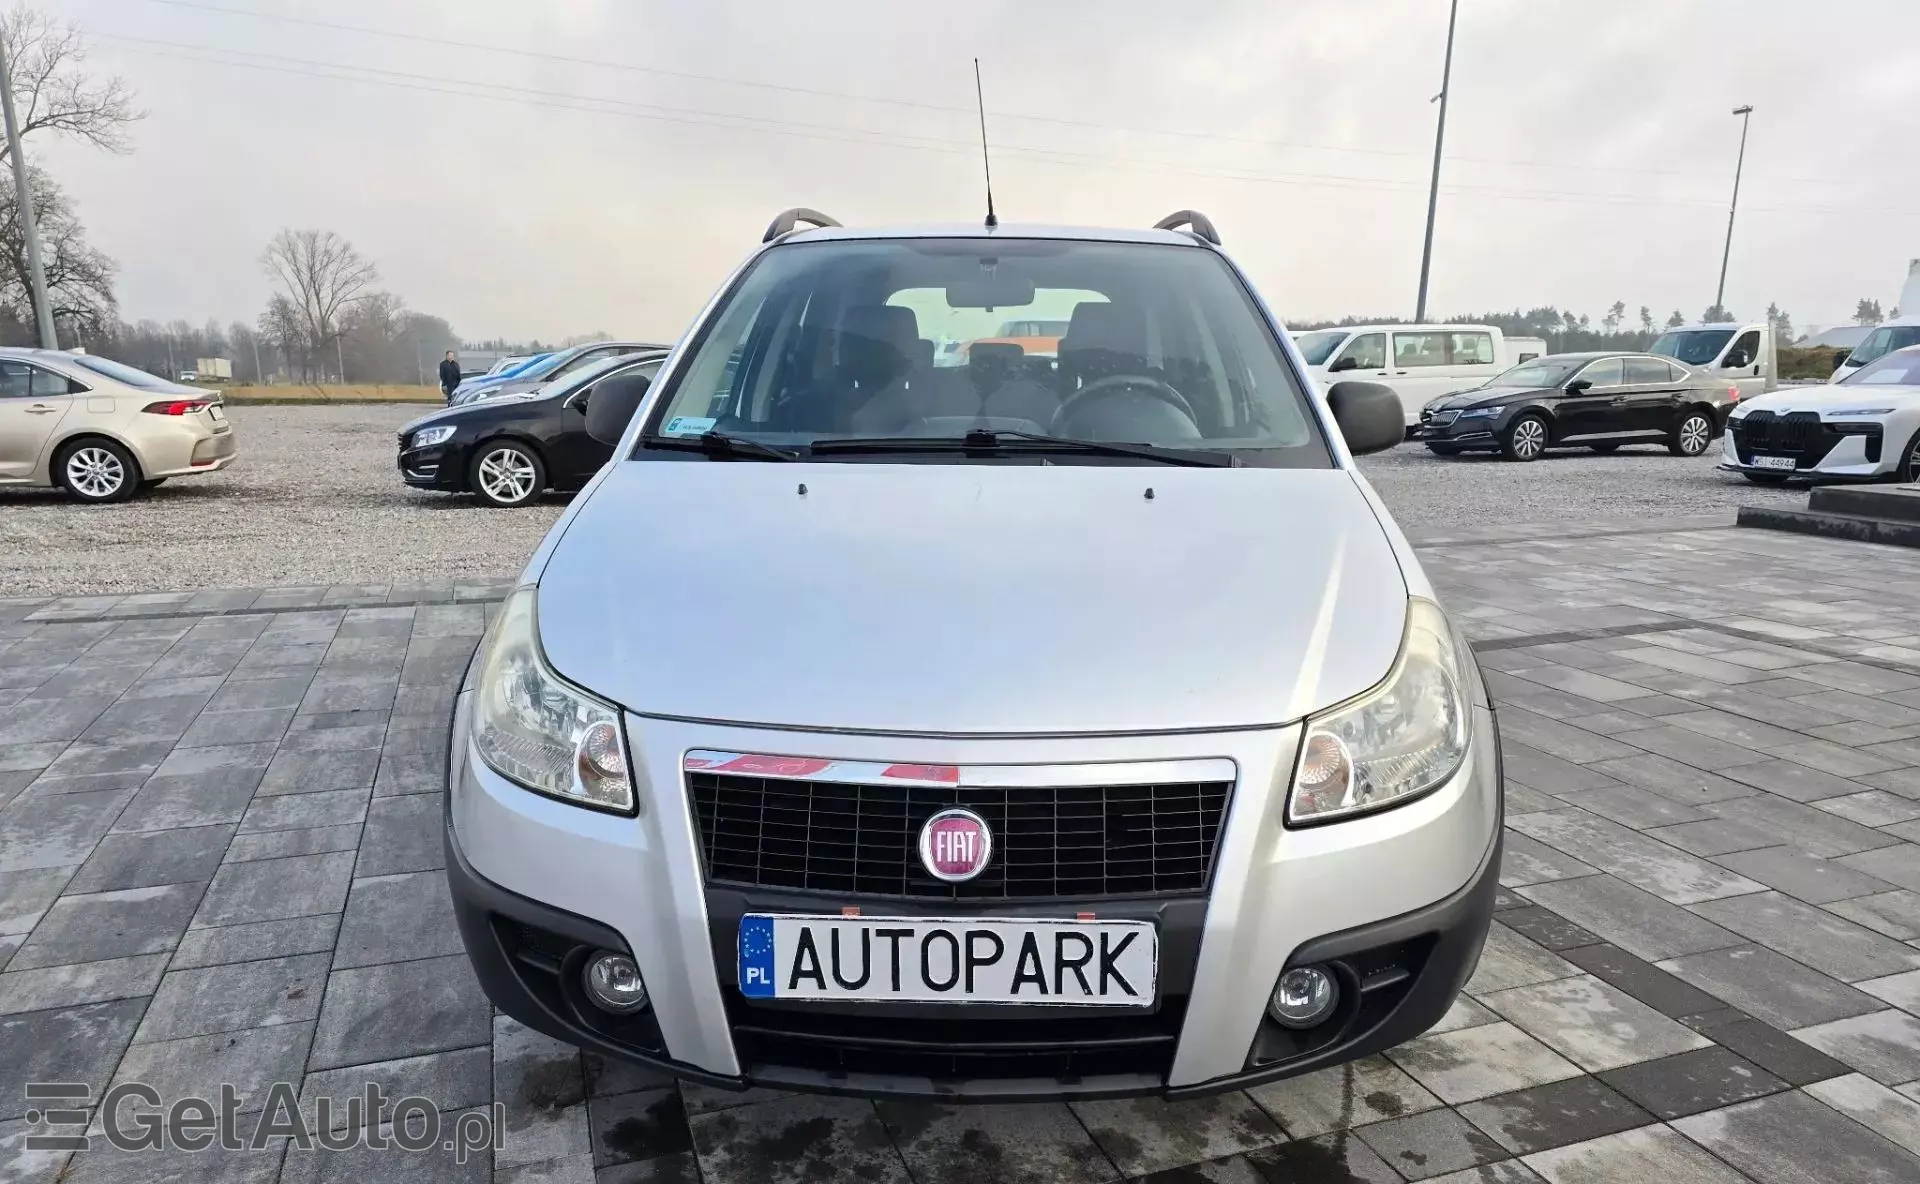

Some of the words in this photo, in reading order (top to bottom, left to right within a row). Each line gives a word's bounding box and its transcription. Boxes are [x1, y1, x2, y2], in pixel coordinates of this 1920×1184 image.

[936, 831, 976, 862] FIAT
[746, 967, 771, 984] PL
[788, 926, 1139, 996] AUTOPARK
